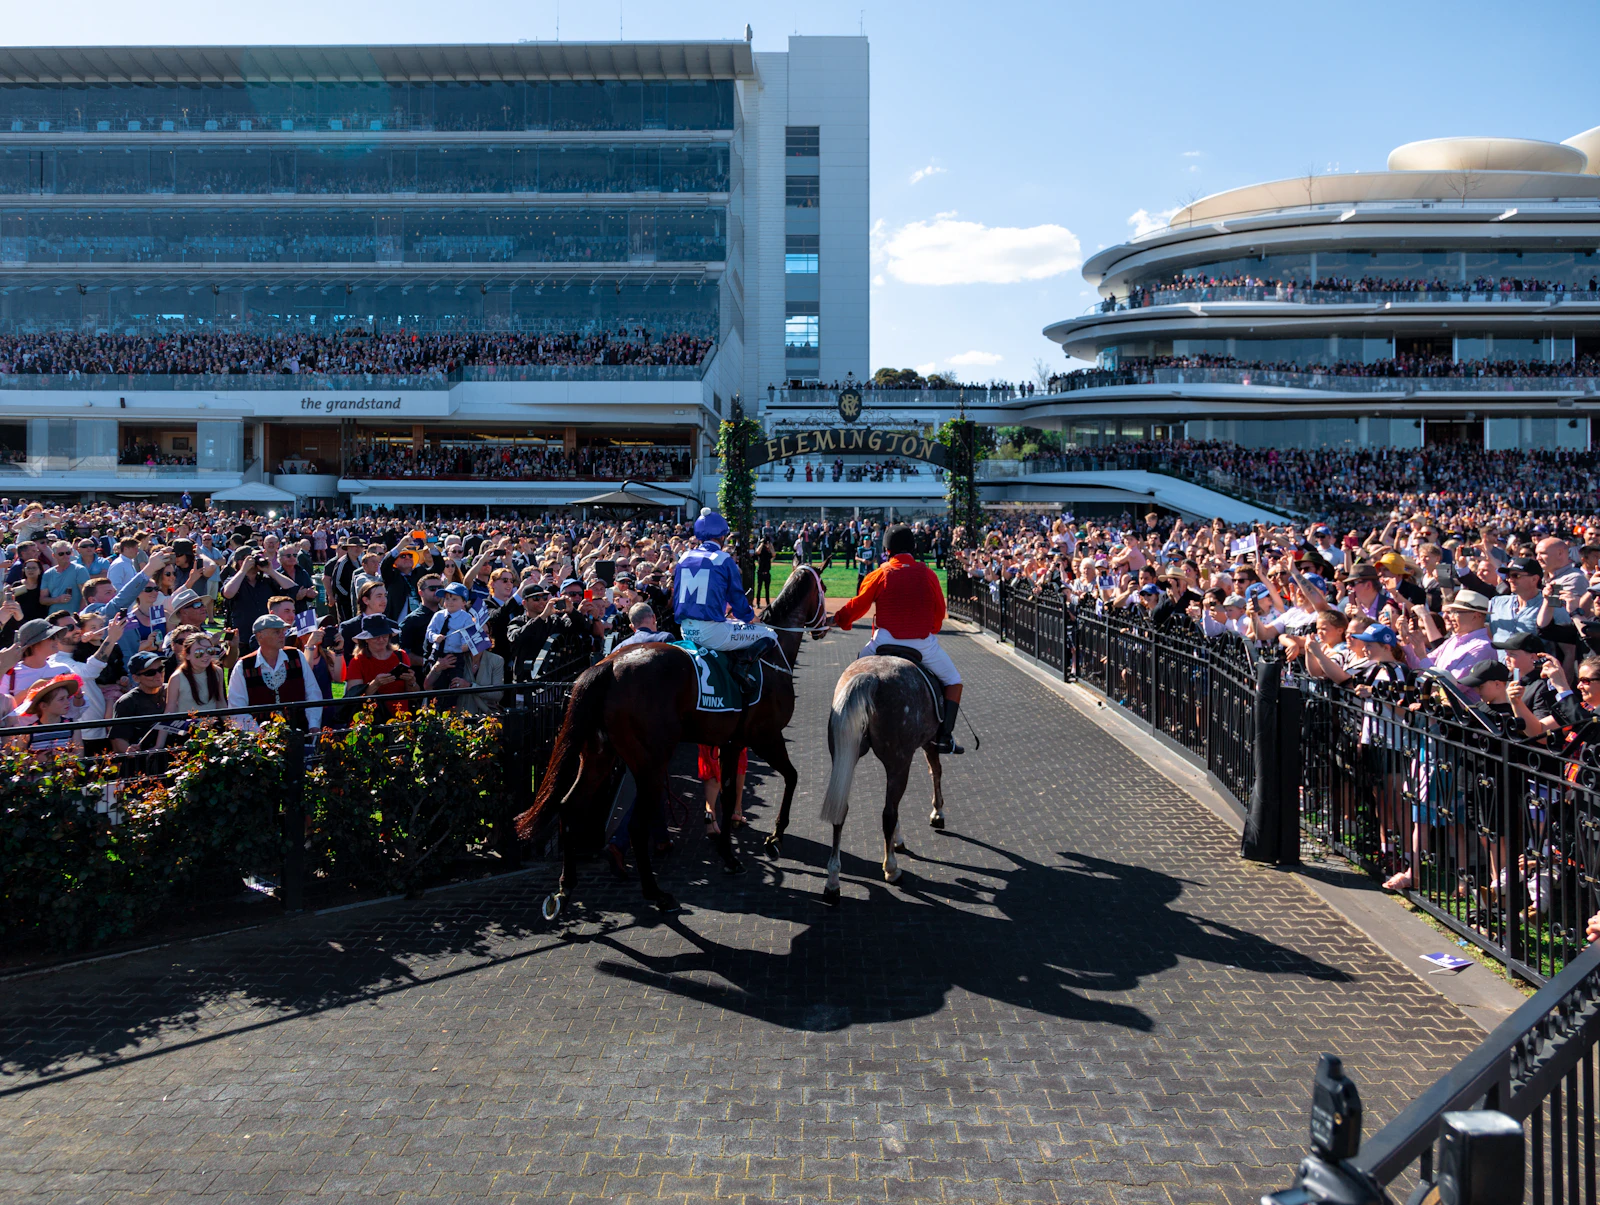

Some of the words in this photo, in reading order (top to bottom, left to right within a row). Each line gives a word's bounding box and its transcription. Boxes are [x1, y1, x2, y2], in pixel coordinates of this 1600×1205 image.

[301, 397, 322, 409] the
[326, 397, 402, 413] grandstand
[764, 430, 937, 461] FLEMINGTON
[679, 568, 710, 605] M
[695, 655, 715, 694] 2
[702, 695, 725, 707] WINX
